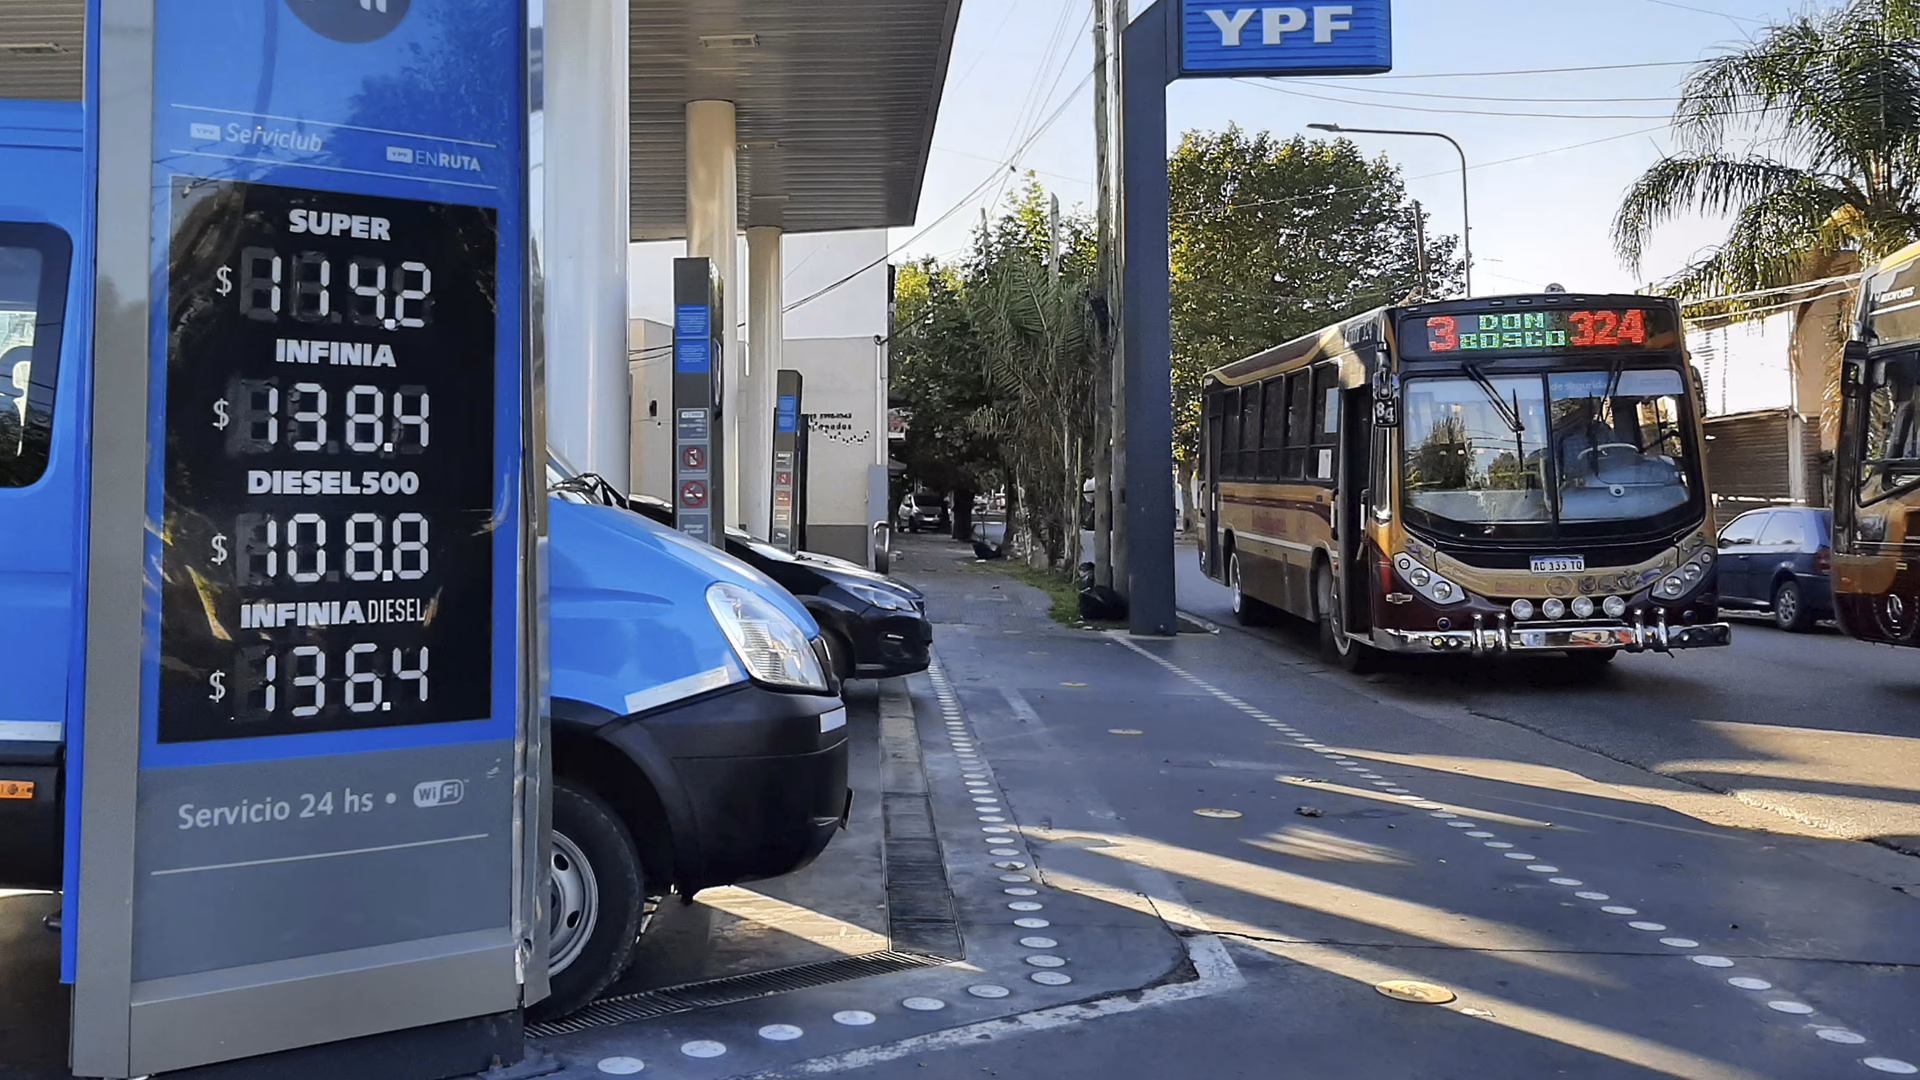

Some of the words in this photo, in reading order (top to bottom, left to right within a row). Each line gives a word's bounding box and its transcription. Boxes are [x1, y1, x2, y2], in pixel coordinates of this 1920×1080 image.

[1204, 6, 1353, 46] YPF
[225, 123, 322, 152] Serviclub
[289, 208, 391, 241] SUPER
[216, 264, 233, 297] $
[1426, 315, 1458, 351] 3
[1478, 312, 1545, 331] DON
[1569, 309, 1645, 347] 324
[1459, 330, 1566, 349] BOSCO
[275, 338, 397, 368] INFINIA
[212, 398, 230, 431] $
[268, 382, 430, 453] 138.4
[1376, 401, 1395, 422] 84
[211, 533, 228, 566] $
[267, 512, 429, 583] 108.8
[209, 669, 226, 702] $
[265, 643, 429, 717] 136.4
[178, 797, 291, 830] Servicio
[300, 791, 334, 818] 24
[344, 787, 374, 814] hs
